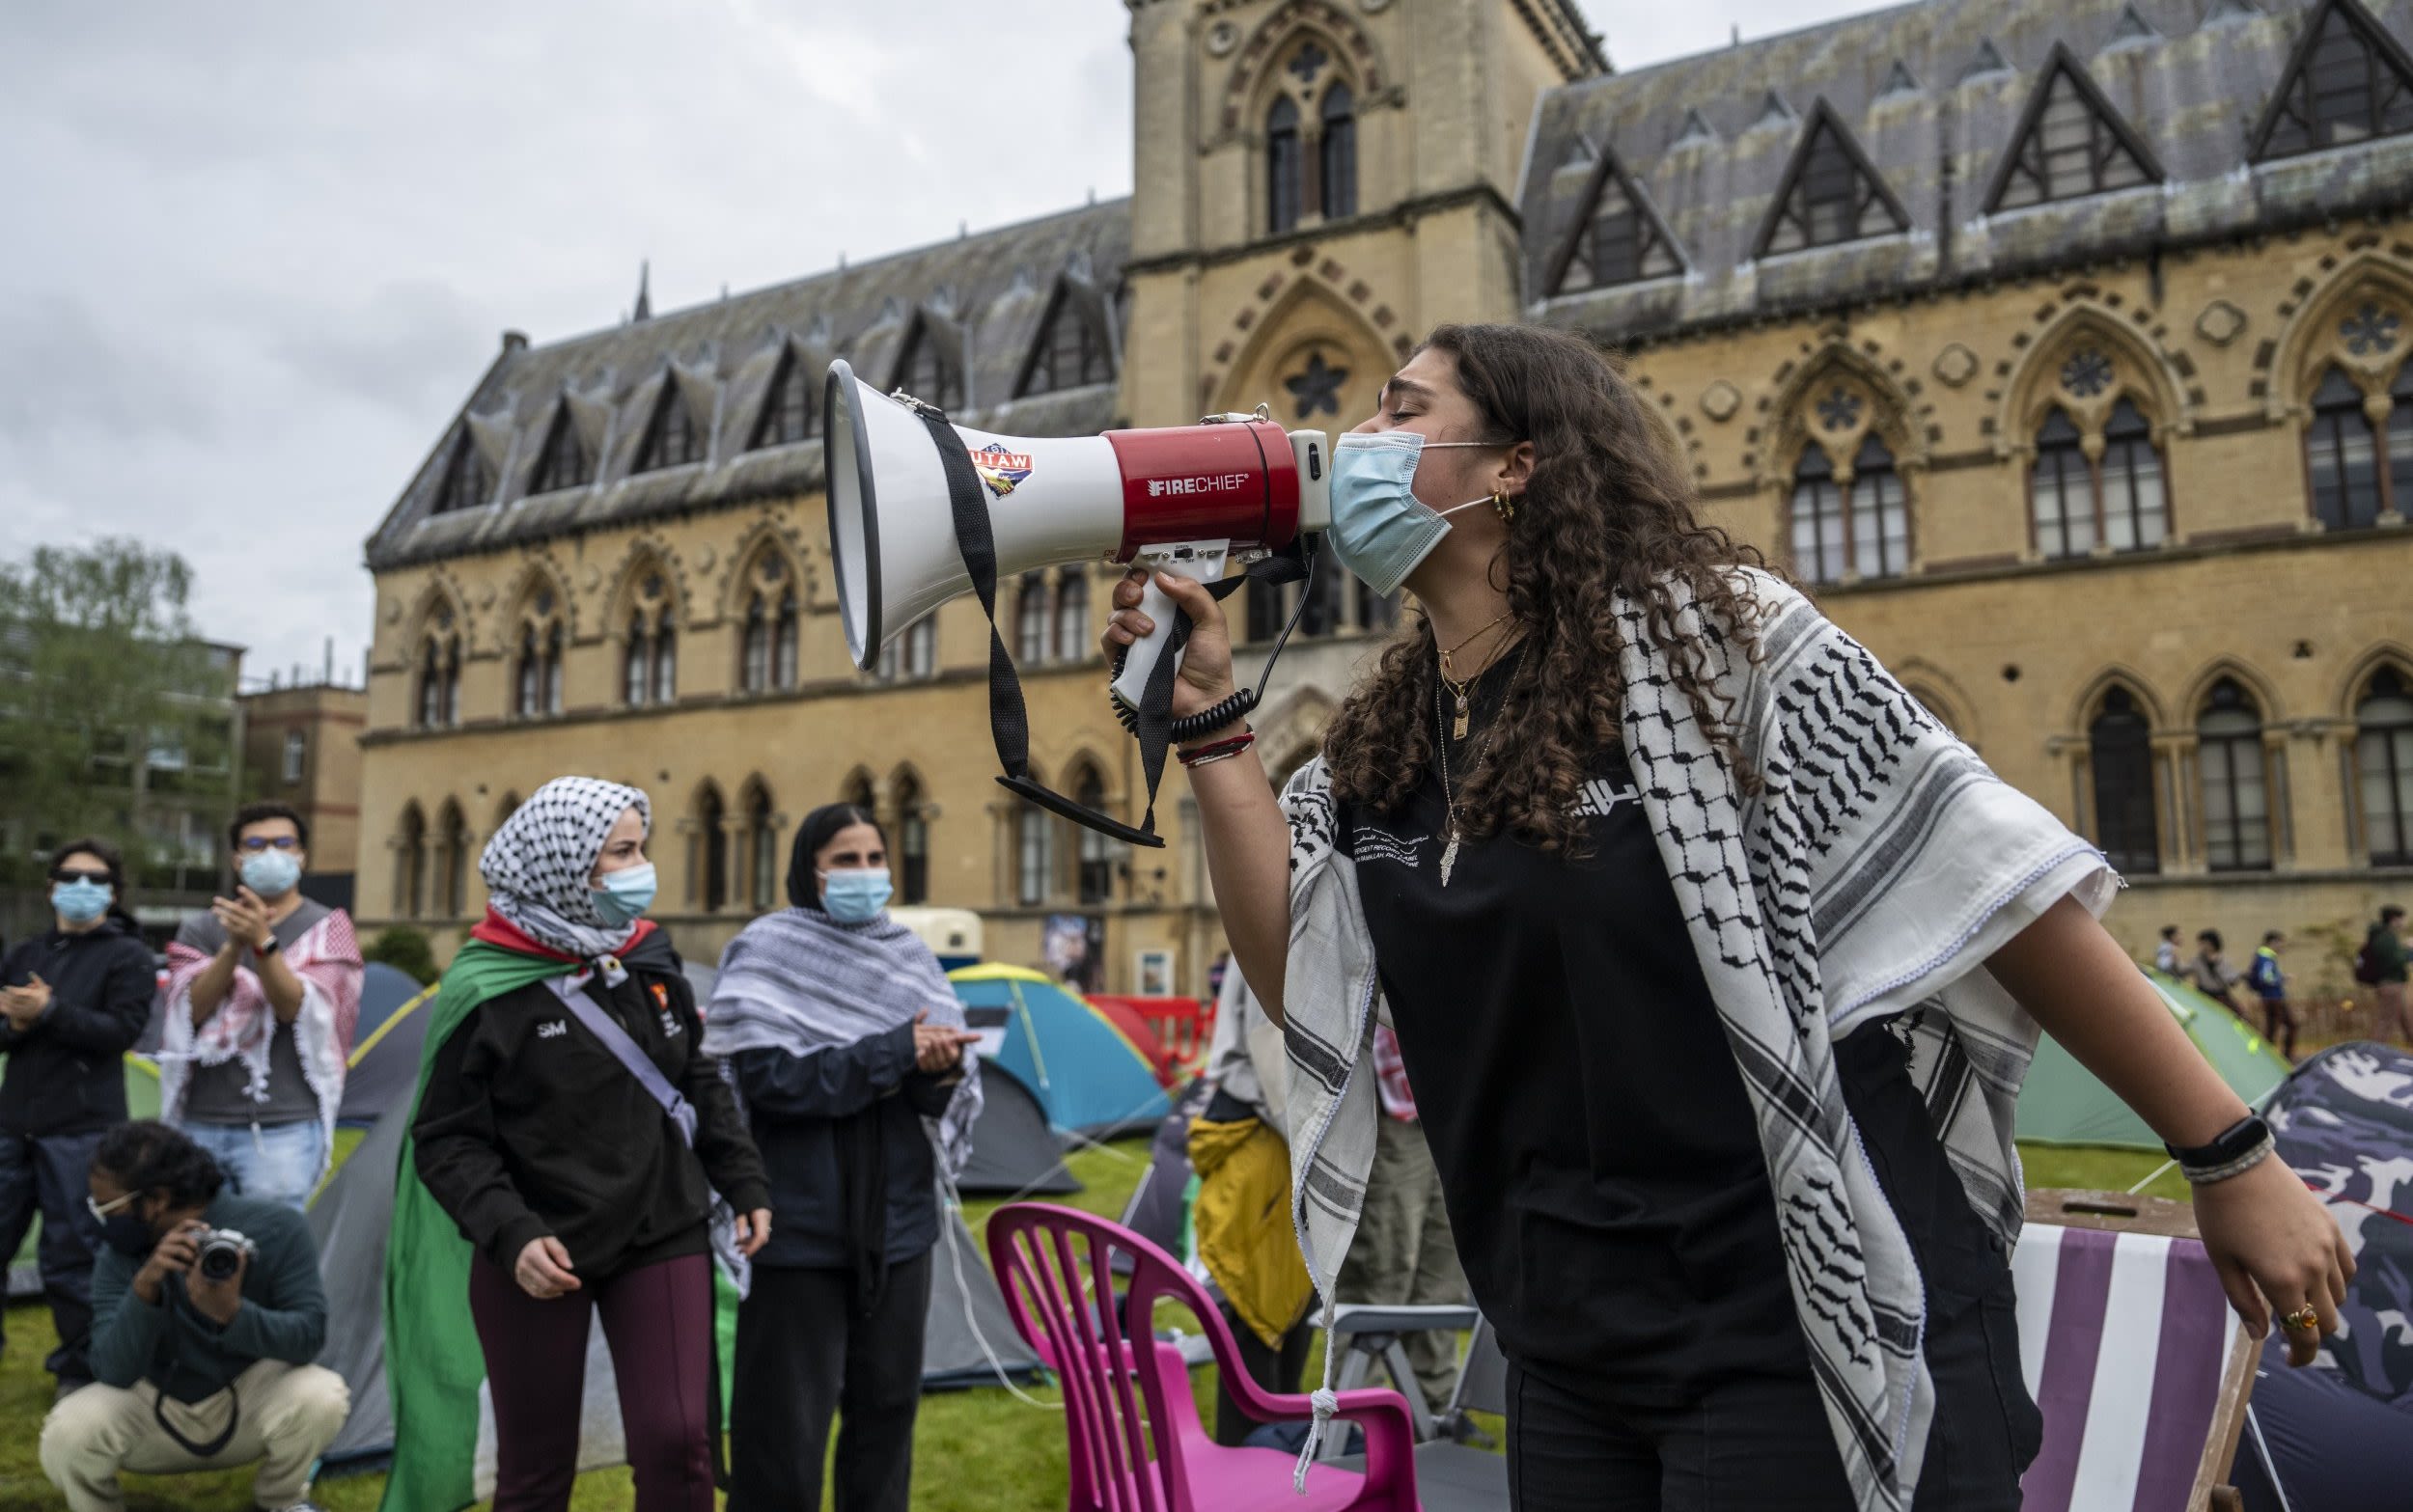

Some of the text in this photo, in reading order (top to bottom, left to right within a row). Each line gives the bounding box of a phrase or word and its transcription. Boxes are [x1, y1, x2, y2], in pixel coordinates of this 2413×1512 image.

[969, 451, 1027, 467] UTAW
[1373, 844, 1401, 855] RECORD
[1385, 852, 1420, 867] PALESTINE
[538, 1019, 568, 1038] SM
